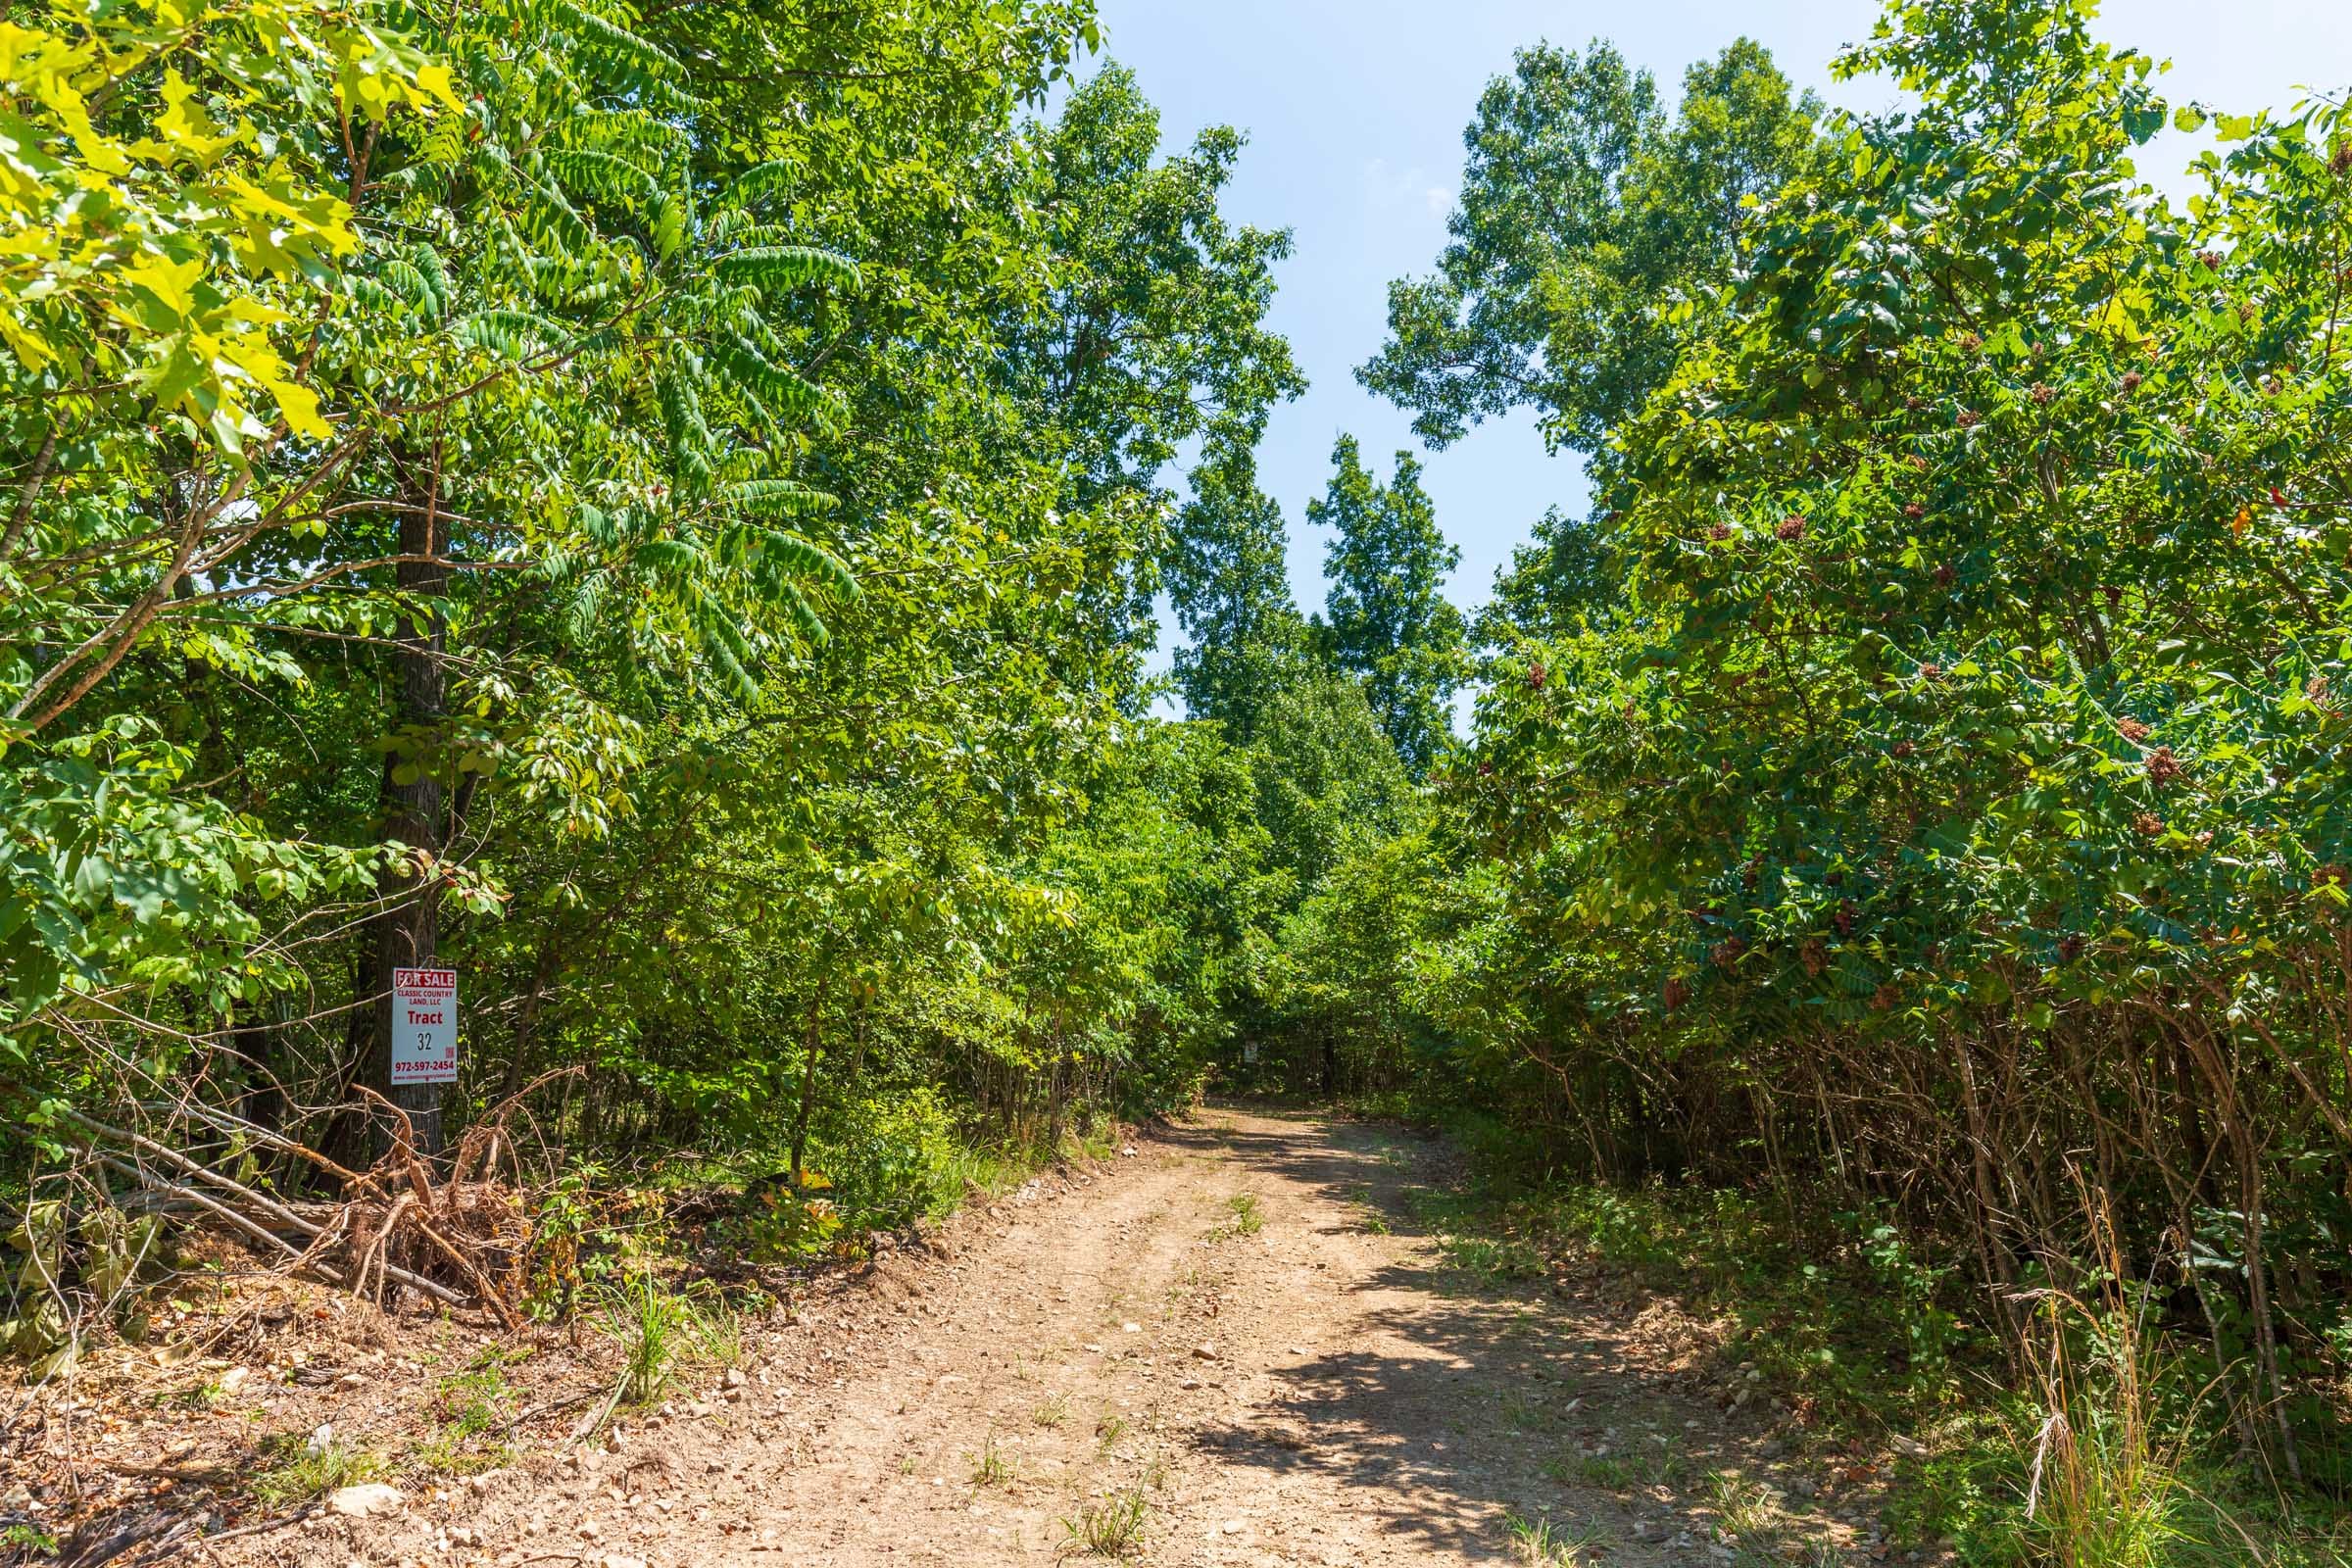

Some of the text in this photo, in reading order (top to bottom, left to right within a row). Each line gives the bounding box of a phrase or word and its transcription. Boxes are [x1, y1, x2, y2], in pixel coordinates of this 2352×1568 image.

[397, 972, 454, 987] FOR SALE
[408, 1010, 443, 1025] Tract
[416, 1033, 431, 1051] 32
[395, 1060, 454, 1072] 972-597-2454
